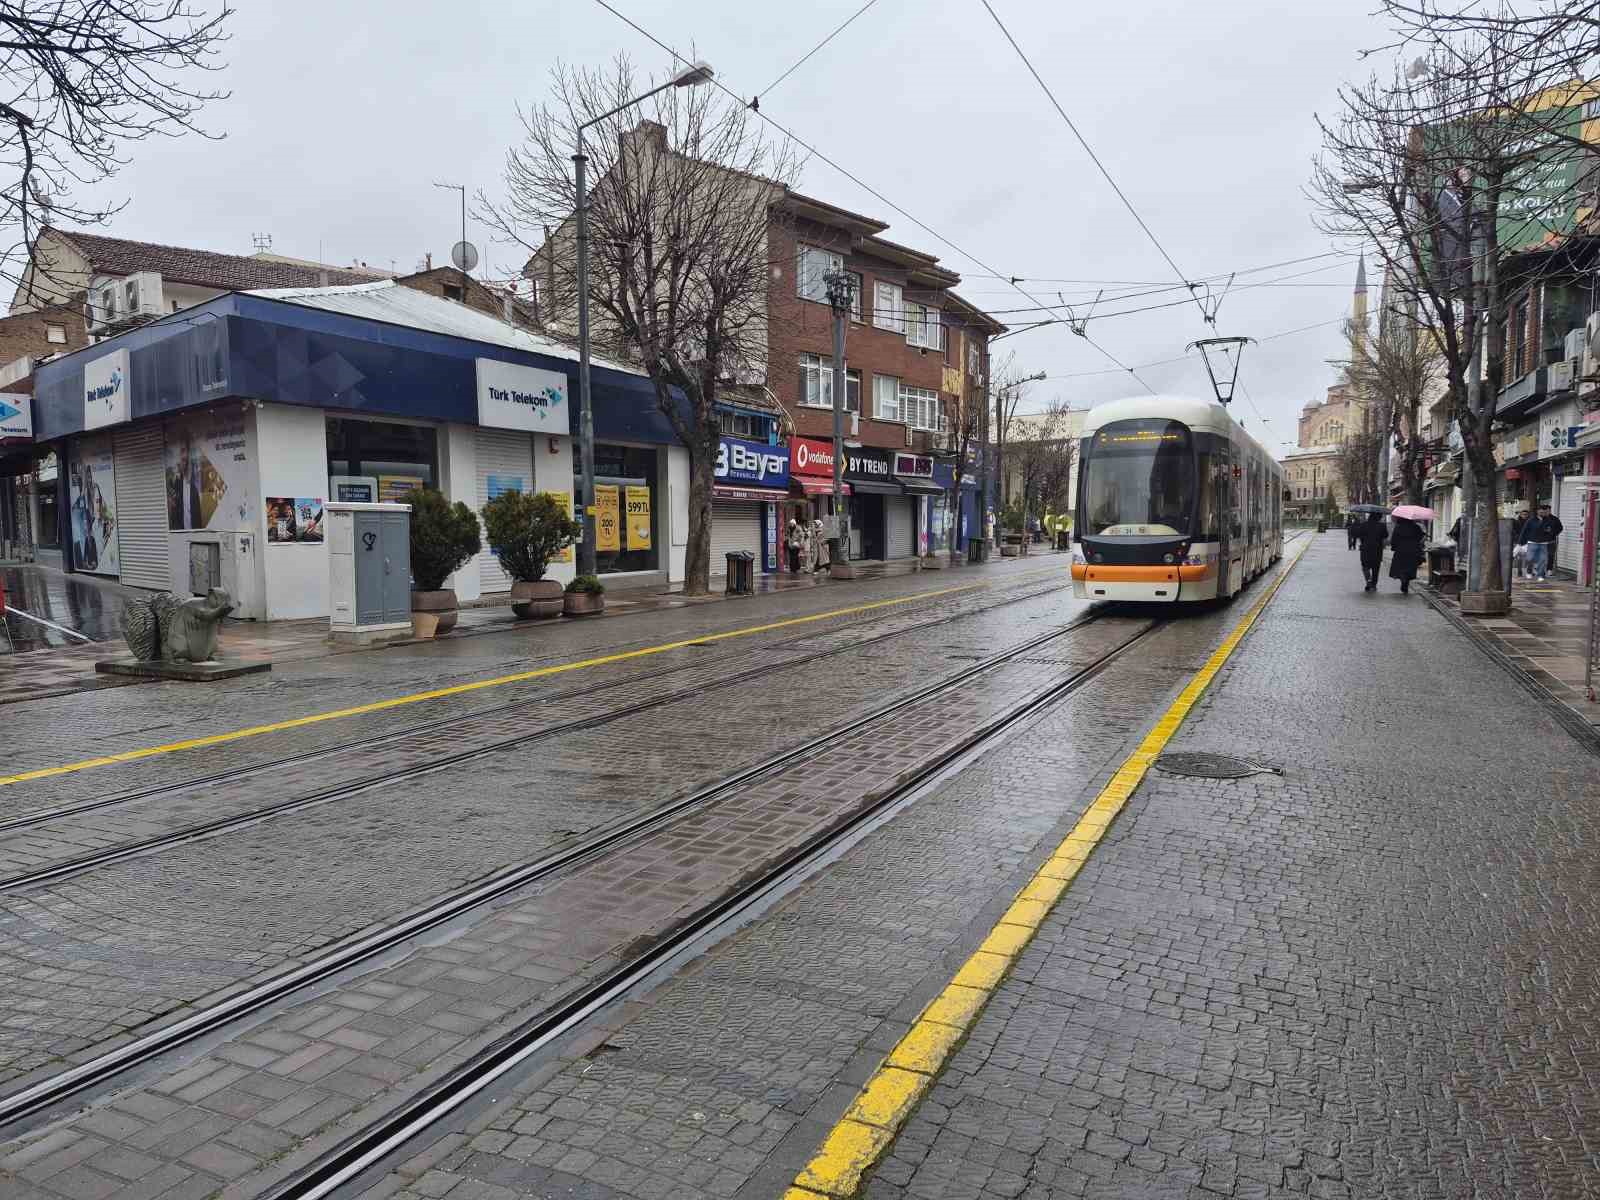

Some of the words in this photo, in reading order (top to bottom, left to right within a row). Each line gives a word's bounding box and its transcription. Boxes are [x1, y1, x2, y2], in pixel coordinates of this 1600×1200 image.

[488, 386, 510, 401] Türk
[511, 391, 548, 408] Telekom
[730, 444, 789, 480] Bayar
[849, 457, 860, 472] BY
[862, 459, 888, 475] TREND
